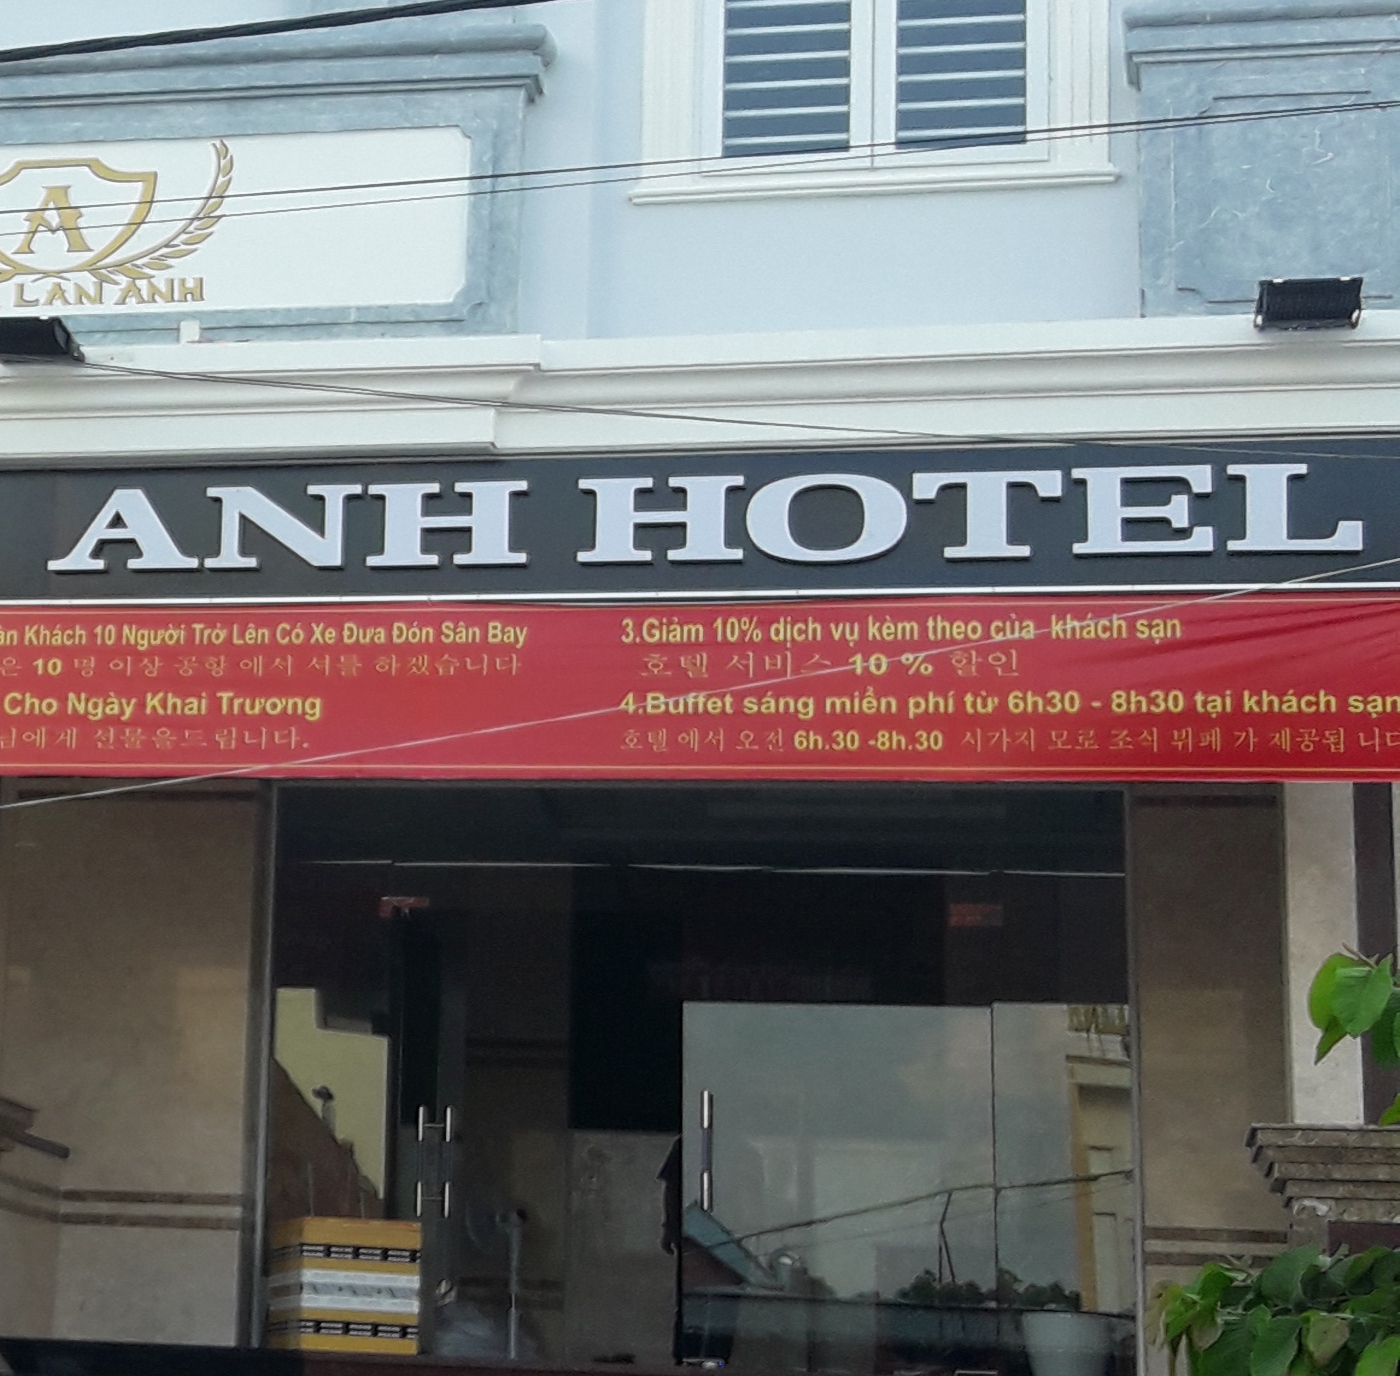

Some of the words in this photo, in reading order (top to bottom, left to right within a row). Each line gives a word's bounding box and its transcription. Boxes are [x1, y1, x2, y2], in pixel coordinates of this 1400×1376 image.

[11, 185, 94, 255] A
[13, 280, 103, 307] LAN
[113, 276, 206, 305] ANH
[46, 479, 529, 571] ANH
[576, 463, 1365, 564] HOTEL
[24, 624, 86, 646] Khách
[94, 624, 115, 645] 10
[232, 622, 268, 645] Lên
[276, 622, 304, 645] Có
[310, 622, 336, 644] Xe
[343, 622, 385, 644] Đưa
[392, 620, 433, 644] Đón
[441, 621, 480, 644] Sân
[488, 620, 527, 649] Bay
[713, 616, 763, 643] 10%
[769, 616, 822, 648] dịch
[830, 622, 860, 647] vụ
[867, 614, 919, 641] kèm
[927, 614, 983, 641] theo
[1051, 612, 1128, 640] khách
[1135, 618, 1182, 645] sạn
[33, 658, 62, 675] 10
[848, 653, 889, 676] 10
[900, 652, 934, 676] %
[4, 692, 58, 715] Cho
[67, 691, 137, 721] Ngày
[146, 691, 208, 715] Khai
[216, 690, 322, 721] Trương
[619, 692, 734, 715] 4.Buffet
[742, 691, 815, 720] sáng
[908, 691, 956, 720] phí
[1007, 690, 1081, 714] 6h30
[1110, 689, 1185, 714] 8h30
[1194, 689, 1232, 719] tại
[1242, 688, 1337, 715] khách
[1346, 693, 1400, 719] sạn
[793, 730, 861, 752] 6h.30
